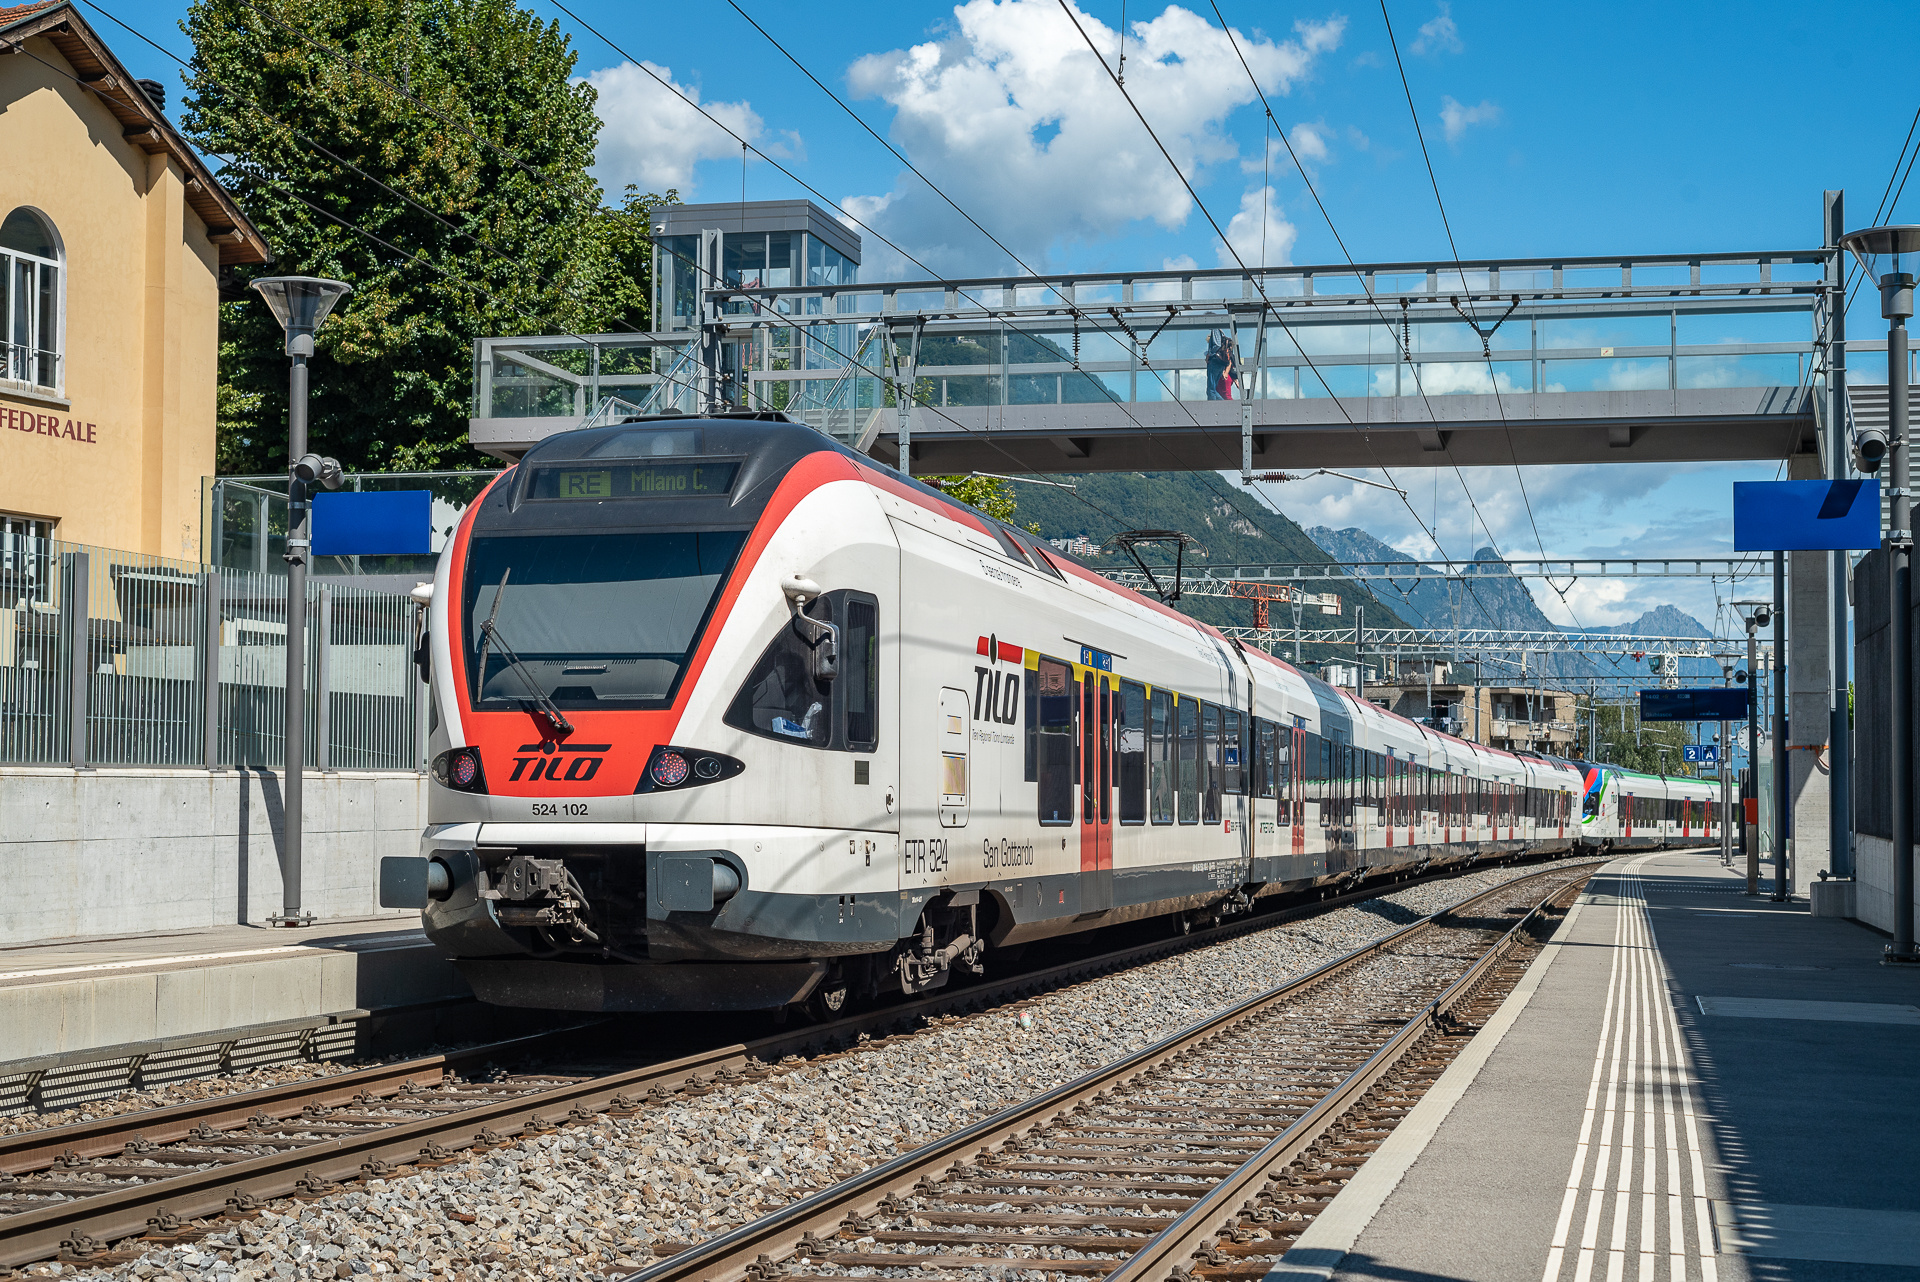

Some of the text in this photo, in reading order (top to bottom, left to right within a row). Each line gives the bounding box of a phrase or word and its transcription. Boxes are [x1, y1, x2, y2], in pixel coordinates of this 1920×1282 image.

[0, 407, 96, 444] FEDERALE
[568, 468, 708, 495] RE Milano C.
[974, 665, 1020, 725] TILO
[1688, 750, 1696, 759] 2
[1705, 751, 1714, 760] A
[508, 757, 603, 781] TILO
[532, 804, 589, 816] 524 102
[904, 838, 949, 875] ETR 524
[983, 837, 1034, 869] San Gottardo
